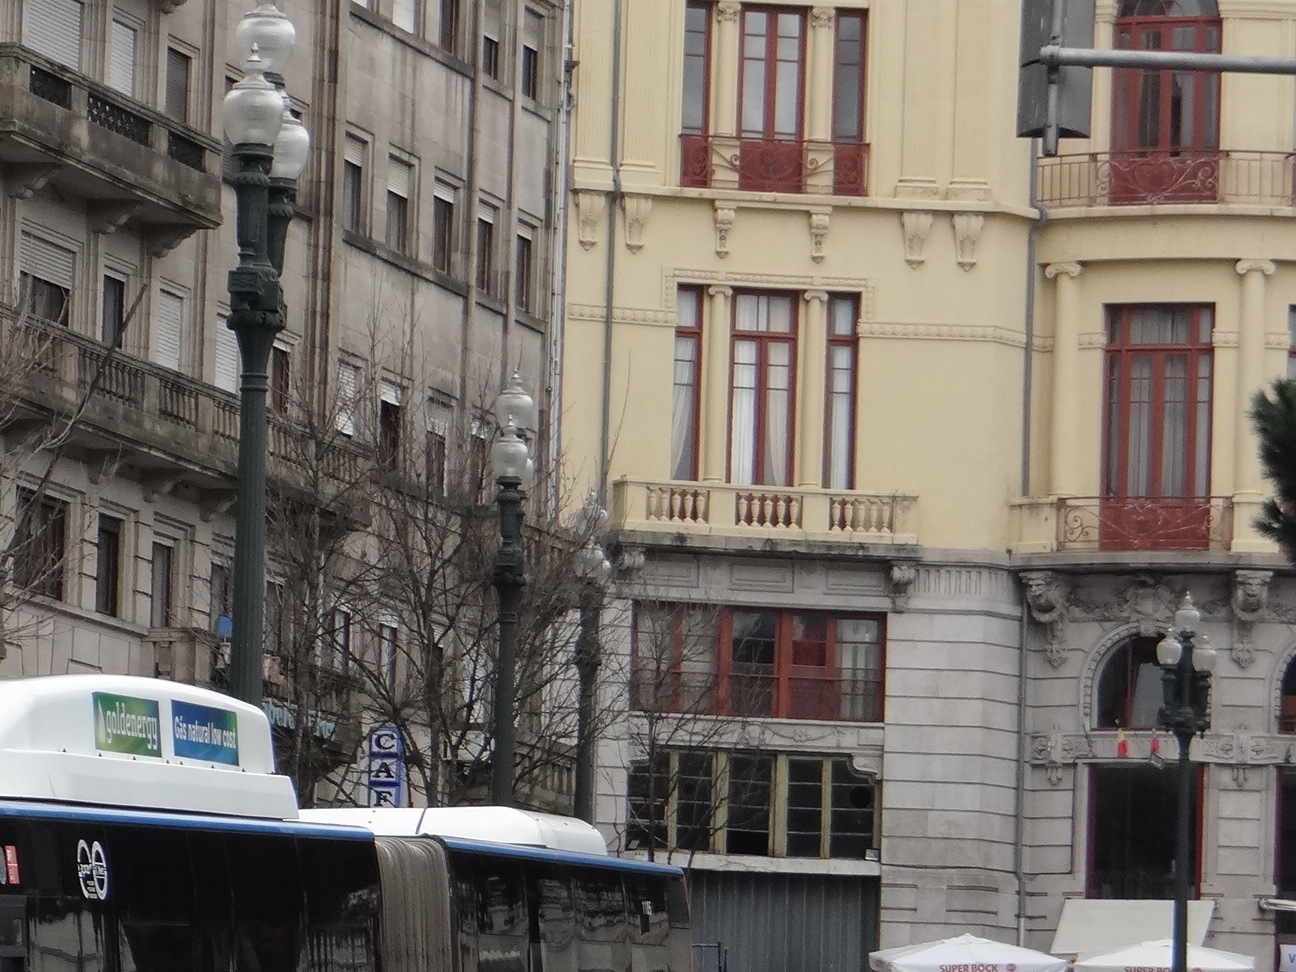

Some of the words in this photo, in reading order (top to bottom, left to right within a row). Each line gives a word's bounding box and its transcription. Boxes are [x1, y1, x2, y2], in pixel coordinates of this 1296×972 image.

[106, 701, 158, 750] goldenergy
[174, 715, 187, 741] Gás
[188, 720, 210, 744] natural
[211, 722, 222, 746] low
[222, 727, 236, 749] cost
[374, 733, 396, 808] CAF
[971, 963, 999, 972] BOCK
